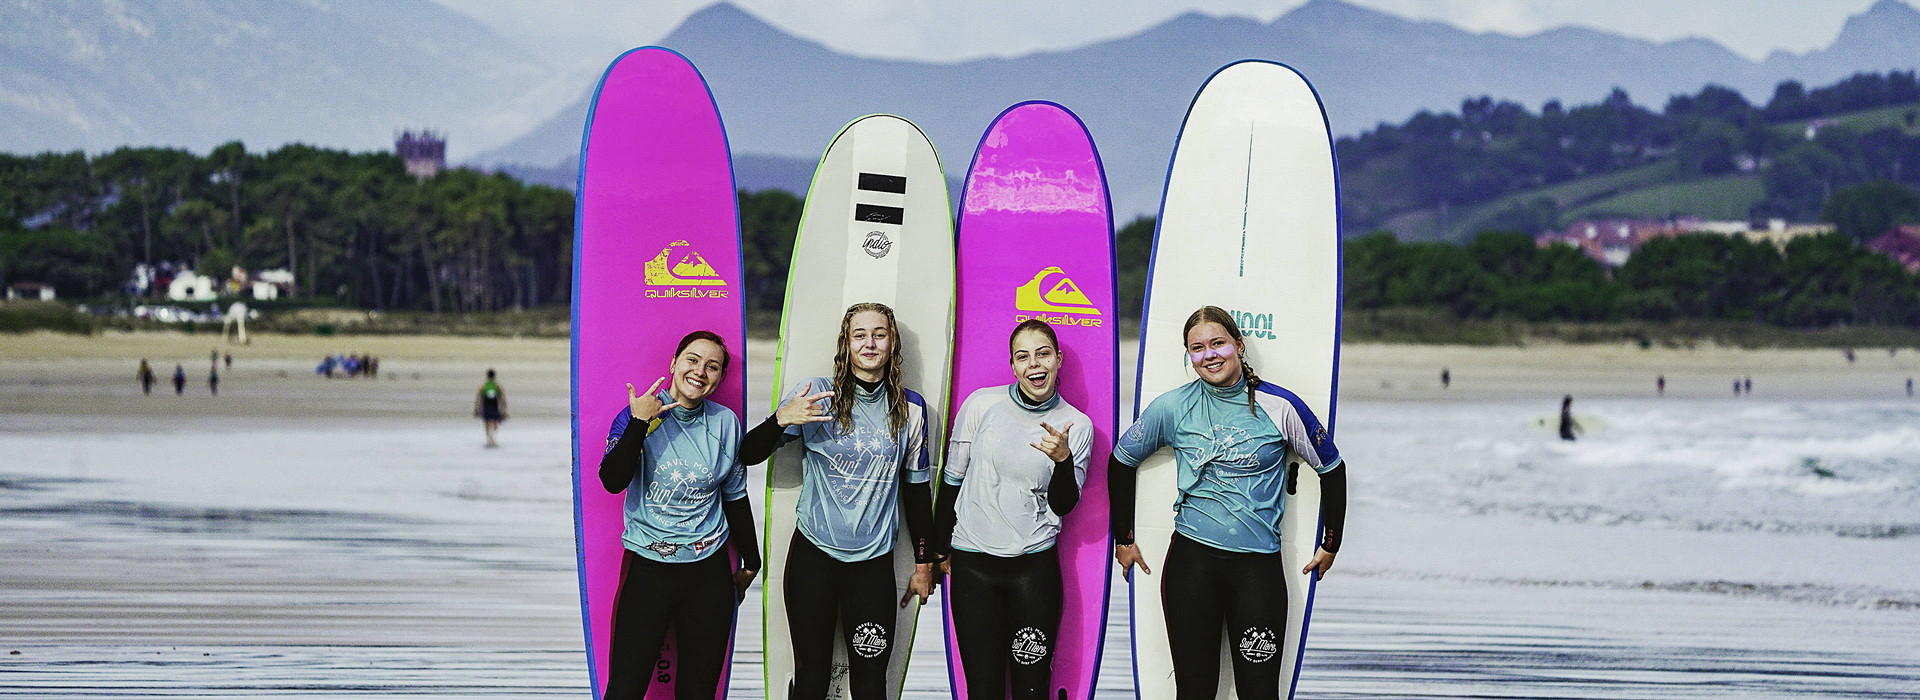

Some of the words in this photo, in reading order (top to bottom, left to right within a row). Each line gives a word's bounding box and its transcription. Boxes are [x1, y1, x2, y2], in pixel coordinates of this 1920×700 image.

[1230, 309, 1277, 340] HOOL
[654, 459, 689, 476] TRAVEL
[693, 462, 715, 485] MORE
[645, 480, 684, 506] Surf
